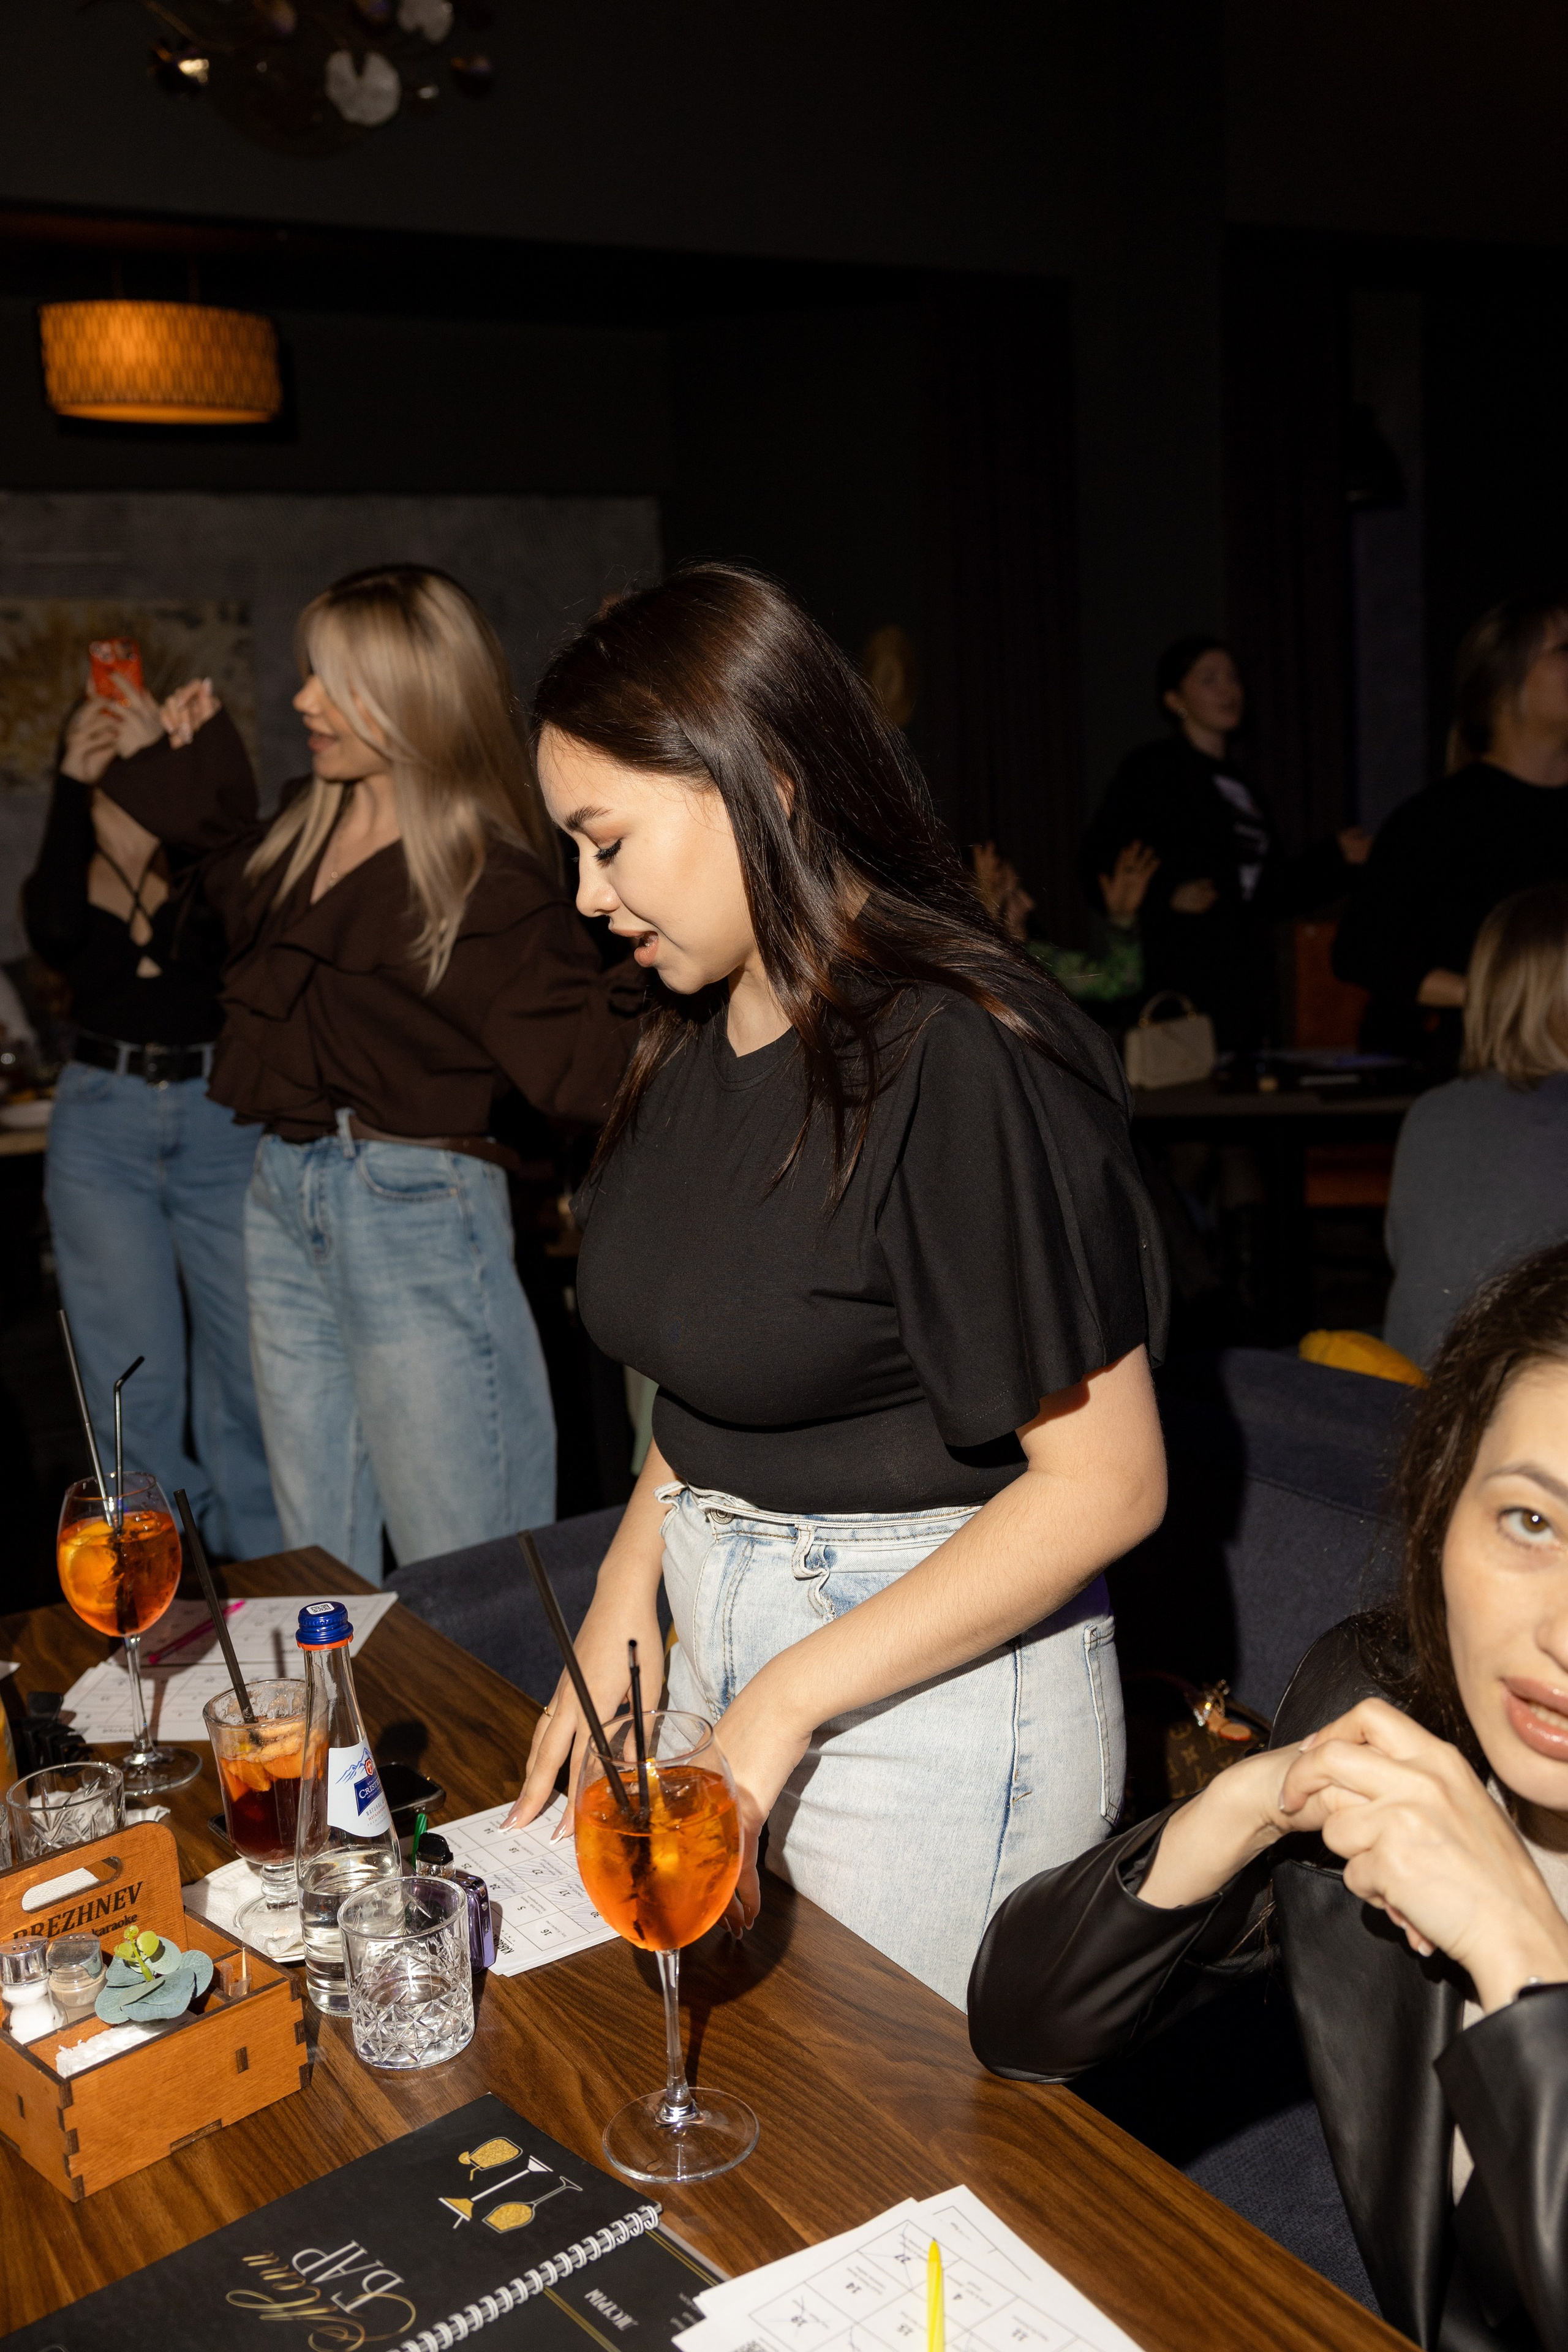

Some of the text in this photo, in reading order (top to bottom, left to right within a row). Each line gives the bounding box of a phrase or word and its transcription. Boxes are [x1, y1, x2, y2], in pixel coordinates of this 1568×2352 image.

[92, 1914, 138, 1937] karaoke
[894, 2253, 911, 2264] 27
[292, 2239, 405, 2314] БАР
